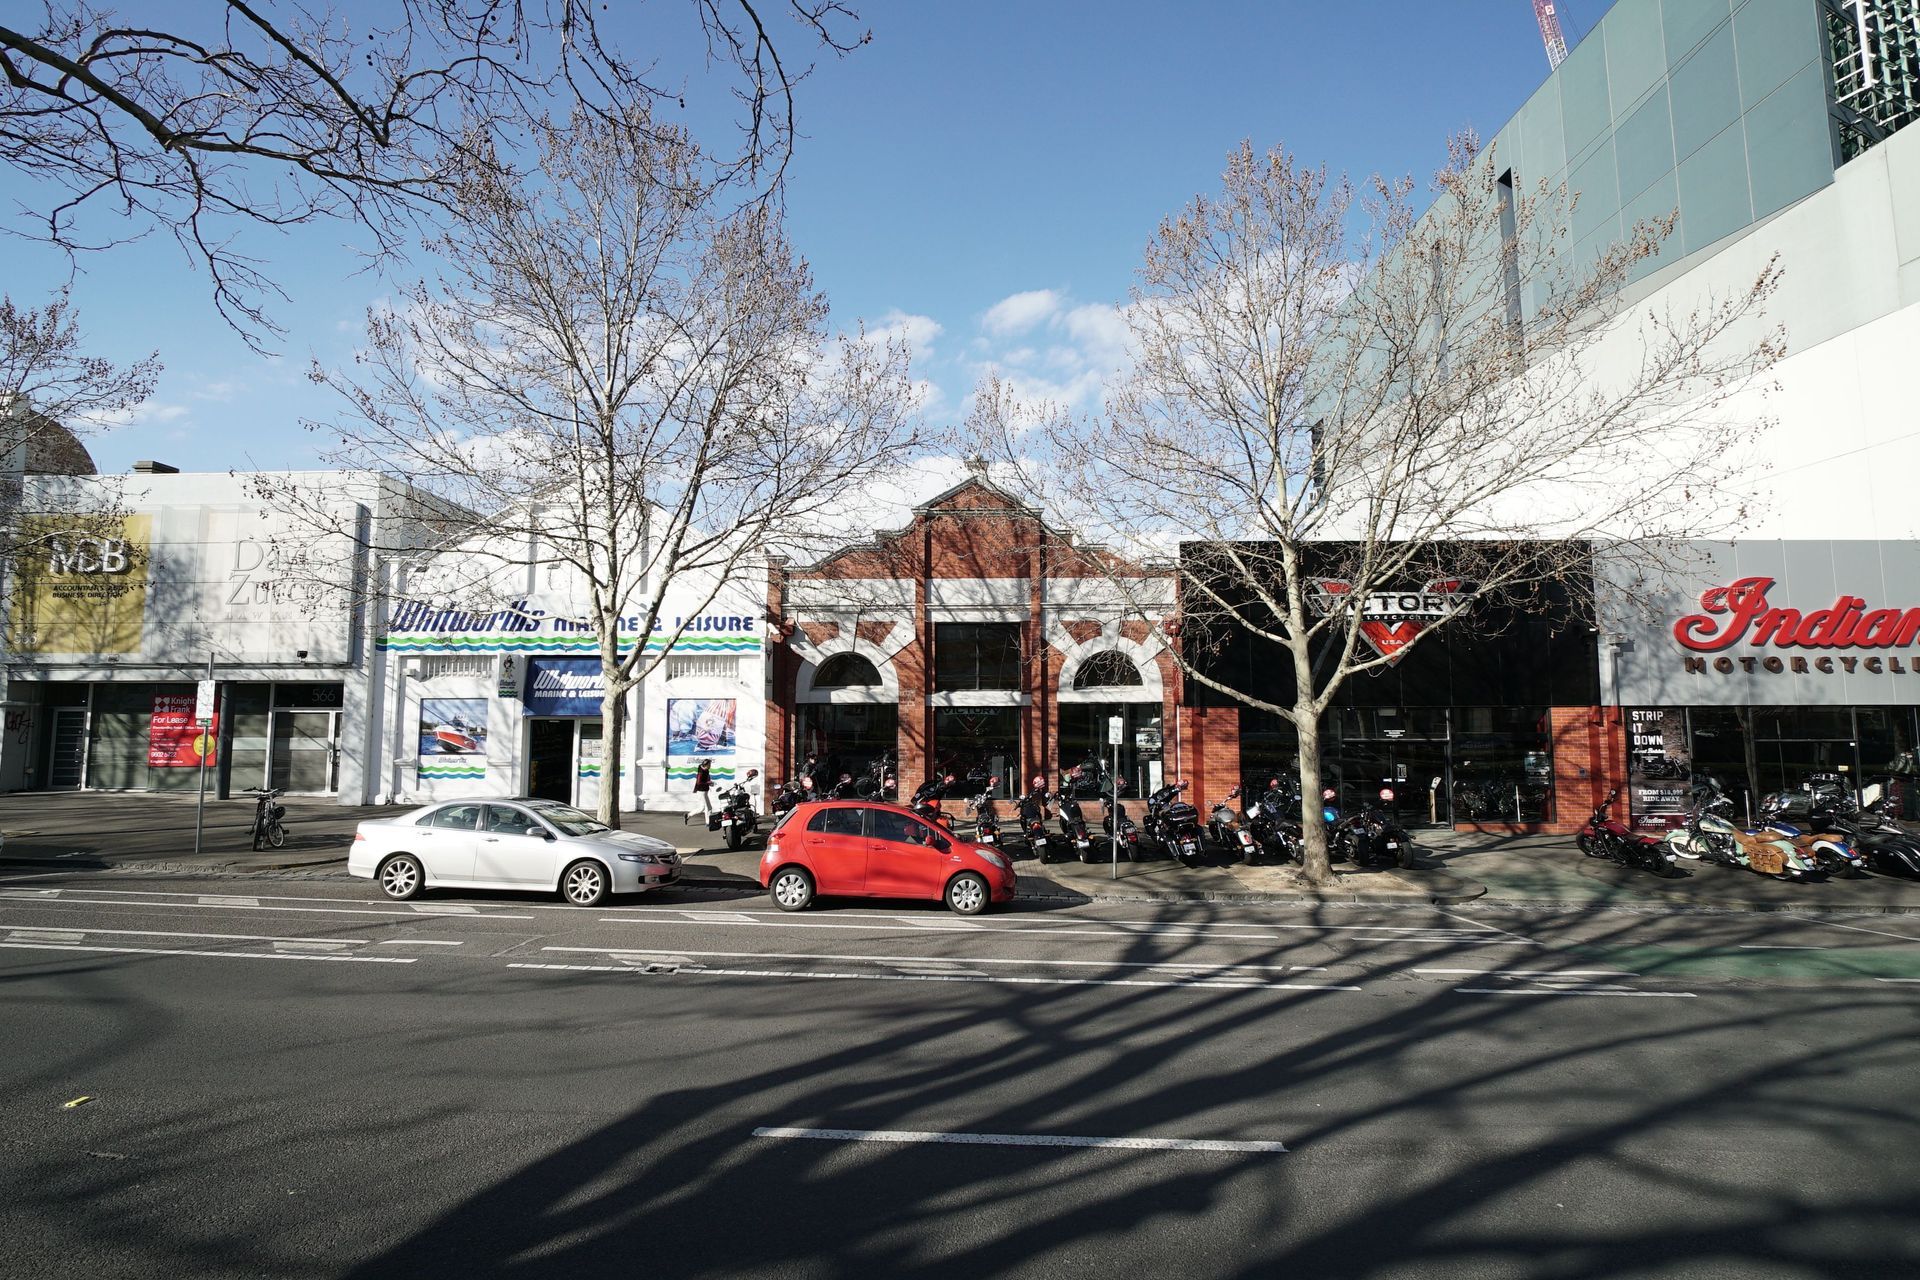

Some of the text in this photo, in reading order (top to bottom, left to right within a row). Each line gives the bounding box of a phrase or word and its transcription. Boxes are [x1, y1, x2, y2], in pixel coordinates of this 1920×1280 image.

[50, 539, 126, 573] MCB
[226, 573, 323, 605] Zucco
[389, 600, 545, 632] Whitworths
[554, 616, 638, 631] MANE
[533, 670, 605, 689] Whitwort
[312, 688, 335, 702] 566
[535, 690, 566, 698] MARINE
[568, 690, 578, 698] &
[171, 697, 195, 705] Knight
[944, 706, 1000, 714] VICTORY
[1632, 711, 1664, 721] STRIP
[1633, 723, 1643, 733] IT
[1634, 735, 1664, 745] DOWN
